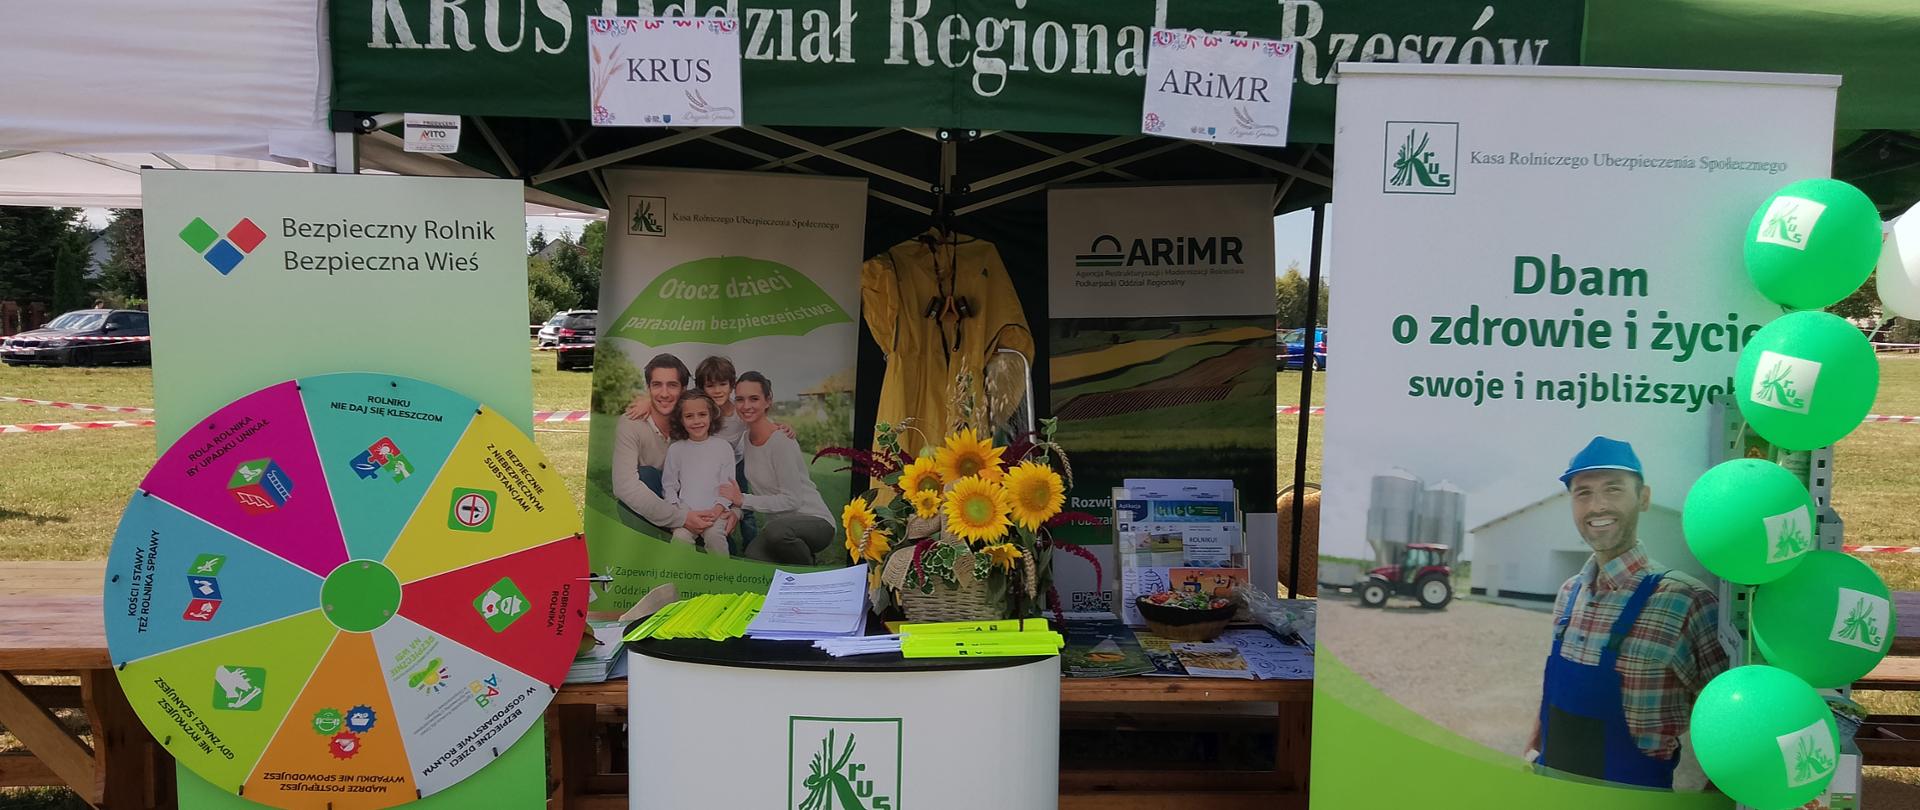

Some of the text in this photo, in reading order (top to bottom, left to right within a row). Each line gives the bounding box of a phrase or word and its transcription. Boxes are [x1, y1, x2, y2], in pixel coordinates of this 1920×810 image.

[367, 0, 573, 54] KRUS
[601, 0, 858, 64] ział
[884, 0, 1248, 97] Regiona
[625, 57, 713, 84] KRUS
[1158, 68, 1271, 104] ARiMR
[1470, 151, 1788, 175] Kasa Rolniczego Ubezpieczenia Społecznego
[282, 217, 496, 243] Bezpieczny Rolnik
[672, 212, 840, 230] Kasa Rolniczego Ubezpieczenia Społecznego
[284, 250, 479, 274] Bezpieczna Wieś
[1126, 236, 1245, 266] ARiMR
[658, 269, 793, 301] Otocz dzieci
[1513, 254, 1649, 298] Dbam
[620, 301, 835, 333] parasolem bezpieczeństwa
[1392, 314, 1419, 346] o
[1430, 305, 1612, 351] zdrowie
[1624, 309, 1637, 350] i
[367, 395, 411, 408] ROLNIKU
[1408, 370, 1504, 407] swoje
[1514, 370, 1525, 401] i
[330, 401, 443, 423] NIE DAJ SIĘ KLESZCZOM
[186, 419, 271, 478] BY UPADKU UNIKAŁ
[188, 416, 254, 463] ROLA ROLNIKA
[484, 457, 532, 512] SUBSTANCJAMI
[486, 443, 545, 513] Z NIEBEZPIECZNYMI
[505, 449, 545, 495] BEZPIECZNIE
[133, 547, 145, 582] STAWY
[615, 566, 773, 586] Zapewnij dzieciom opiekę dorosły
[137, 530, 160, 634] TEŻ ROLNIKA SPRAWY
[128, 588, 139, 616] KOŚCI
[547, 591, 560, 628] ROLNIKA
[556, 584, 571, 636] DOBROSTAN
[154, 677, 195, 718] SZANUJESZ
[526, 686, 537, 697] W
[158, 698, 213, 754] NIE RYZYKUJESZ
[195, 720, 221, 745] ZNASZ
[457, 694, 526, 751] GOSPODARSTWIE
[476, 708, 523, 744] BEZPIECZNE
[217, 744, 235, 760] GDY
[422, 746, 458, 777] ROLNYM
[449, 744, 477, 768] DZIECI
[263, 772, 337, 782] SPOWODUJESZ
[280, 782, 387, 793] MĄDRZE POSTĘPUJESZ
[356, 775, 405, 783] WYPADKU
